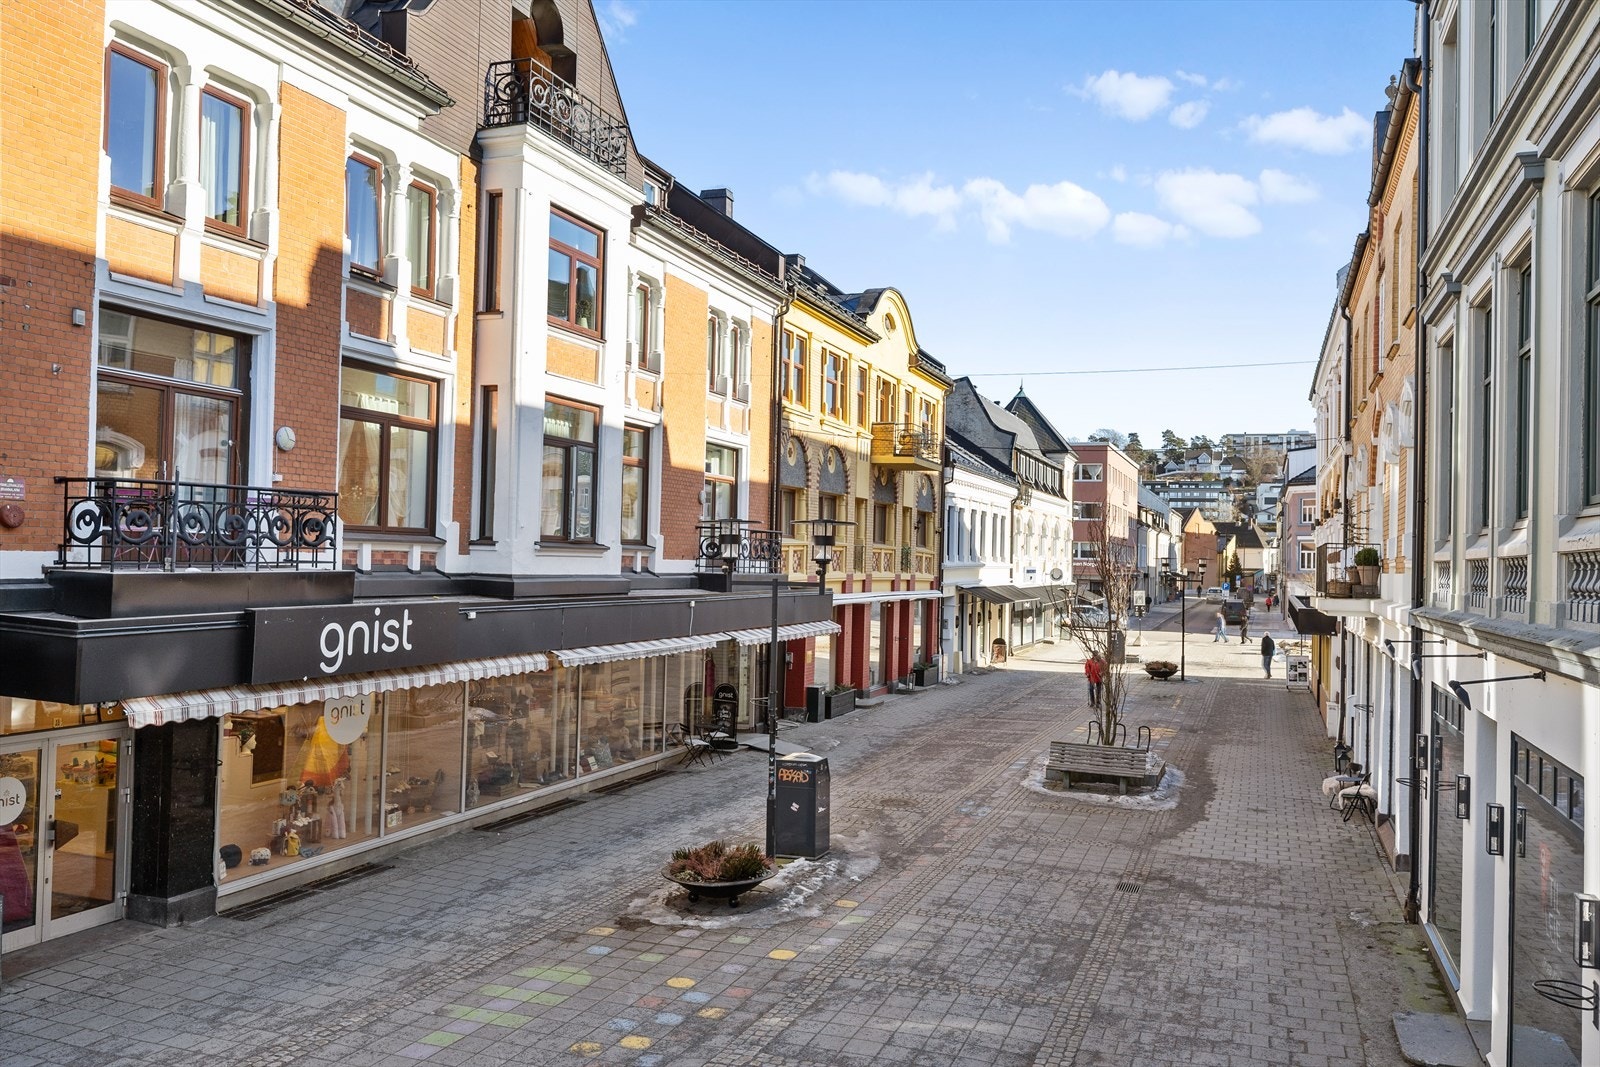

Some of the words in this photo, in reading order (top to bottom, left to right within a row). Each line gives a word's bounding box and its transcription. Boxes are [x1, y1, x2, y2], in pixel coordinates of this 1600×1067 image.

[319, 607, 413, 674] gnist
[718, 691, 734, 699] gnist
[330, 699, 365, 725] gnist
[0, 793, 20, 807] nist
